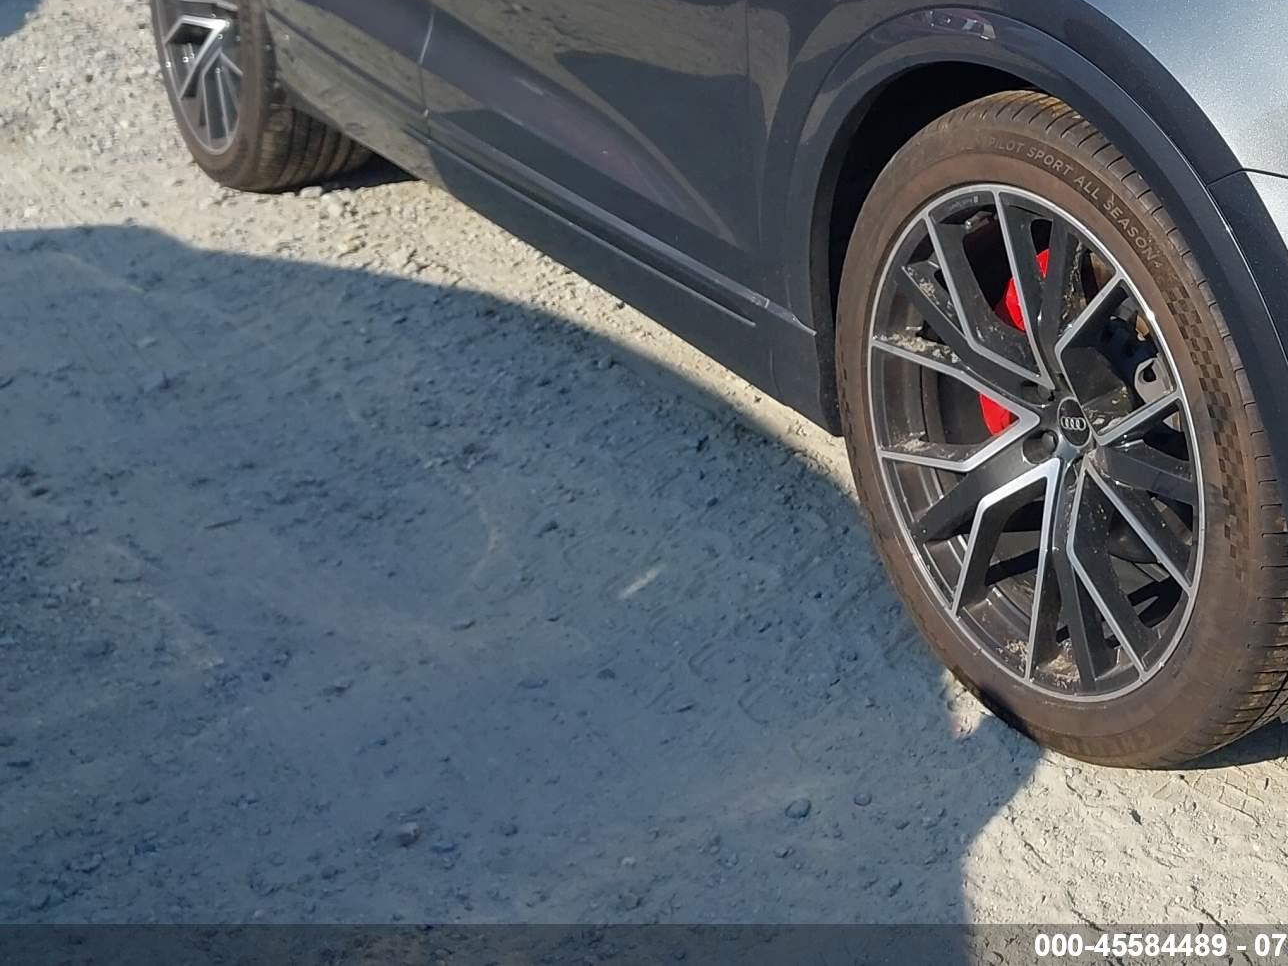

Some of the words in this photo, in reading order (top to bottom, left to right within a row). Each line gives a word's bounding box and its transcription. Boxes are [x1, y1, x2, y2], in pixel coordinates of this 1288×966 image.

[990, 137, 1024, 153] PILOT
[1026, 147, 1074, 176] SPORT
[1073, 176, 1099, 200] ALL
[1103, 200, 1158, 261] SEASON
